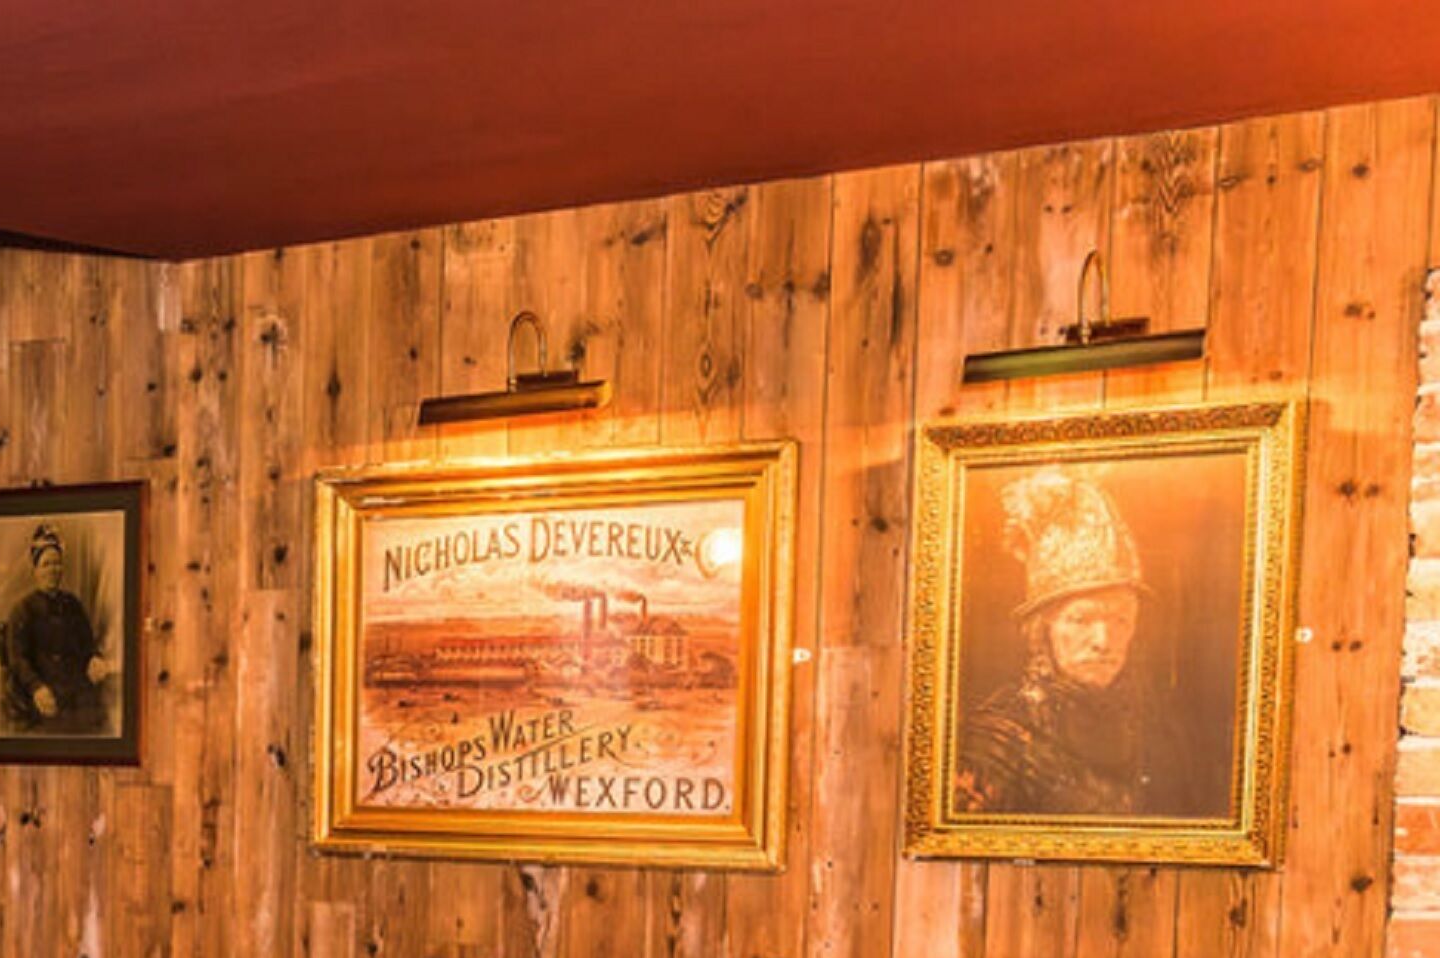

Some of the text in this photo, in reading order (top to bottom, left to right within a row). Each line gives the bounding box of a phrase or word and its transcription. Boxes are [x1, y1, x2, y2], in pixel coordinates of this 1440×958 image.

[383, 525, 520, 592] NICHOLAS
[488, 708, 574, 750] WATER
[542, 774, 732, 811] WEXFORD.
